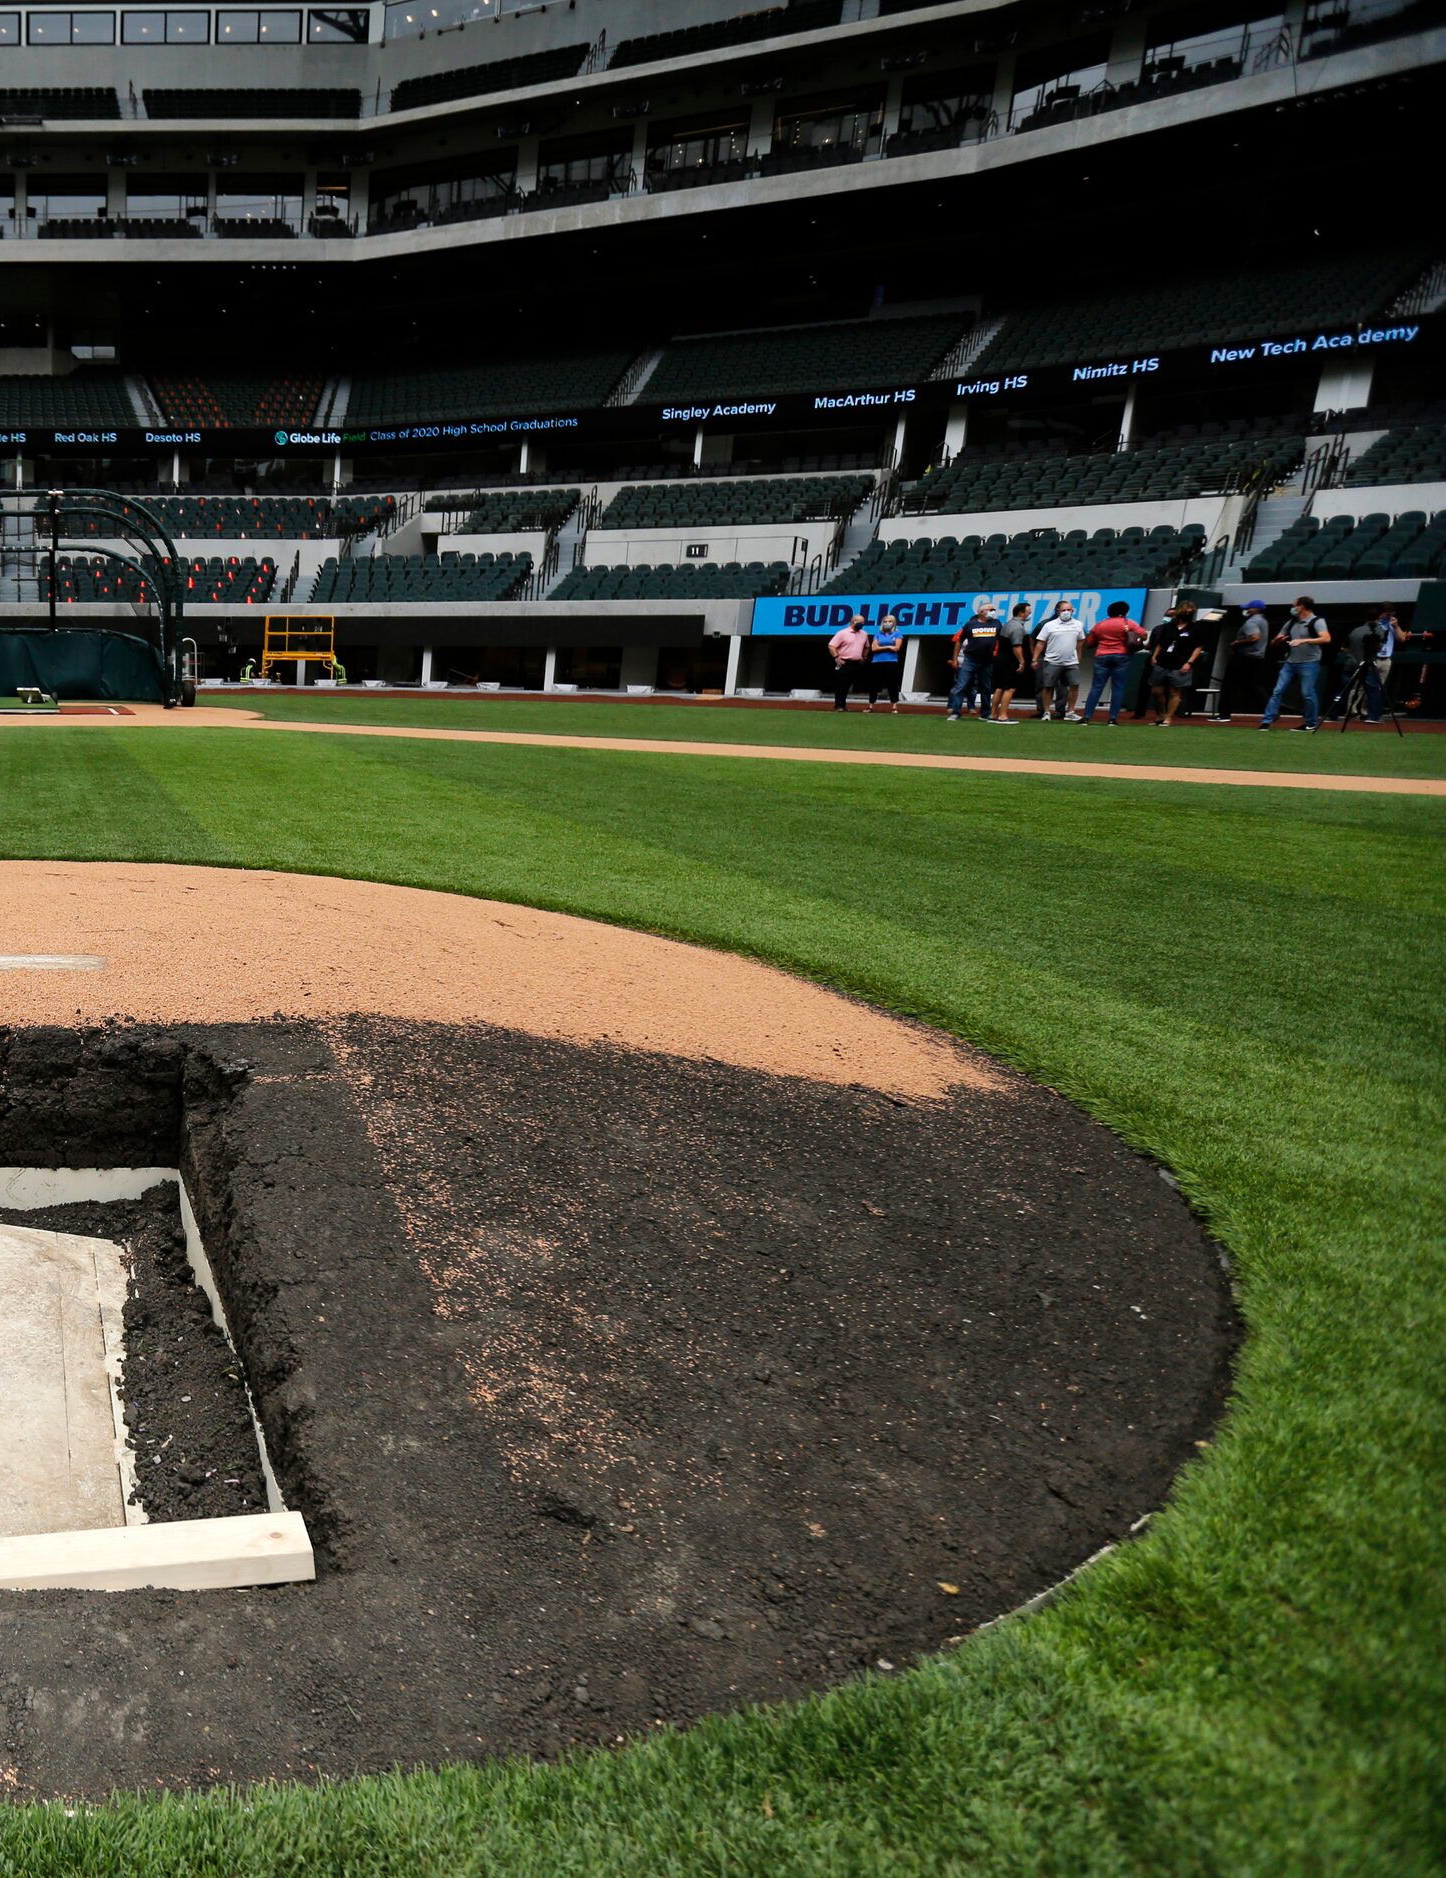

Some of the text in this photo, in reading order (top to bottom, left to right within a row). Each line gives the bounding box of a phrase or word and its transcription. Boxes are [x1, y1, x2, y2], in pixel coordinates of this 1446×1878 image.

[1210, 347, 1255, 363] New
[1261, 339, 1308, 357] Tech
[1073, 358, 1160, 381] Nimitz HS
[956, 375, 1028, 396] Irving HS
[814, 389, 916, 409] MacArthur HS
[662, 402, 776, 421] Singley Academy
[10, 433, 27, 443] HS
[54, 432, 117, 443] Red Oak HS
[145, 432, 201, 443] Desoto HS
[290, 417, 578, 444] Globe Life Field Class of 2020 High School Graduations
[783, 604, 853, 627] BUD
[859, 602, 966, 626] LIGHT
